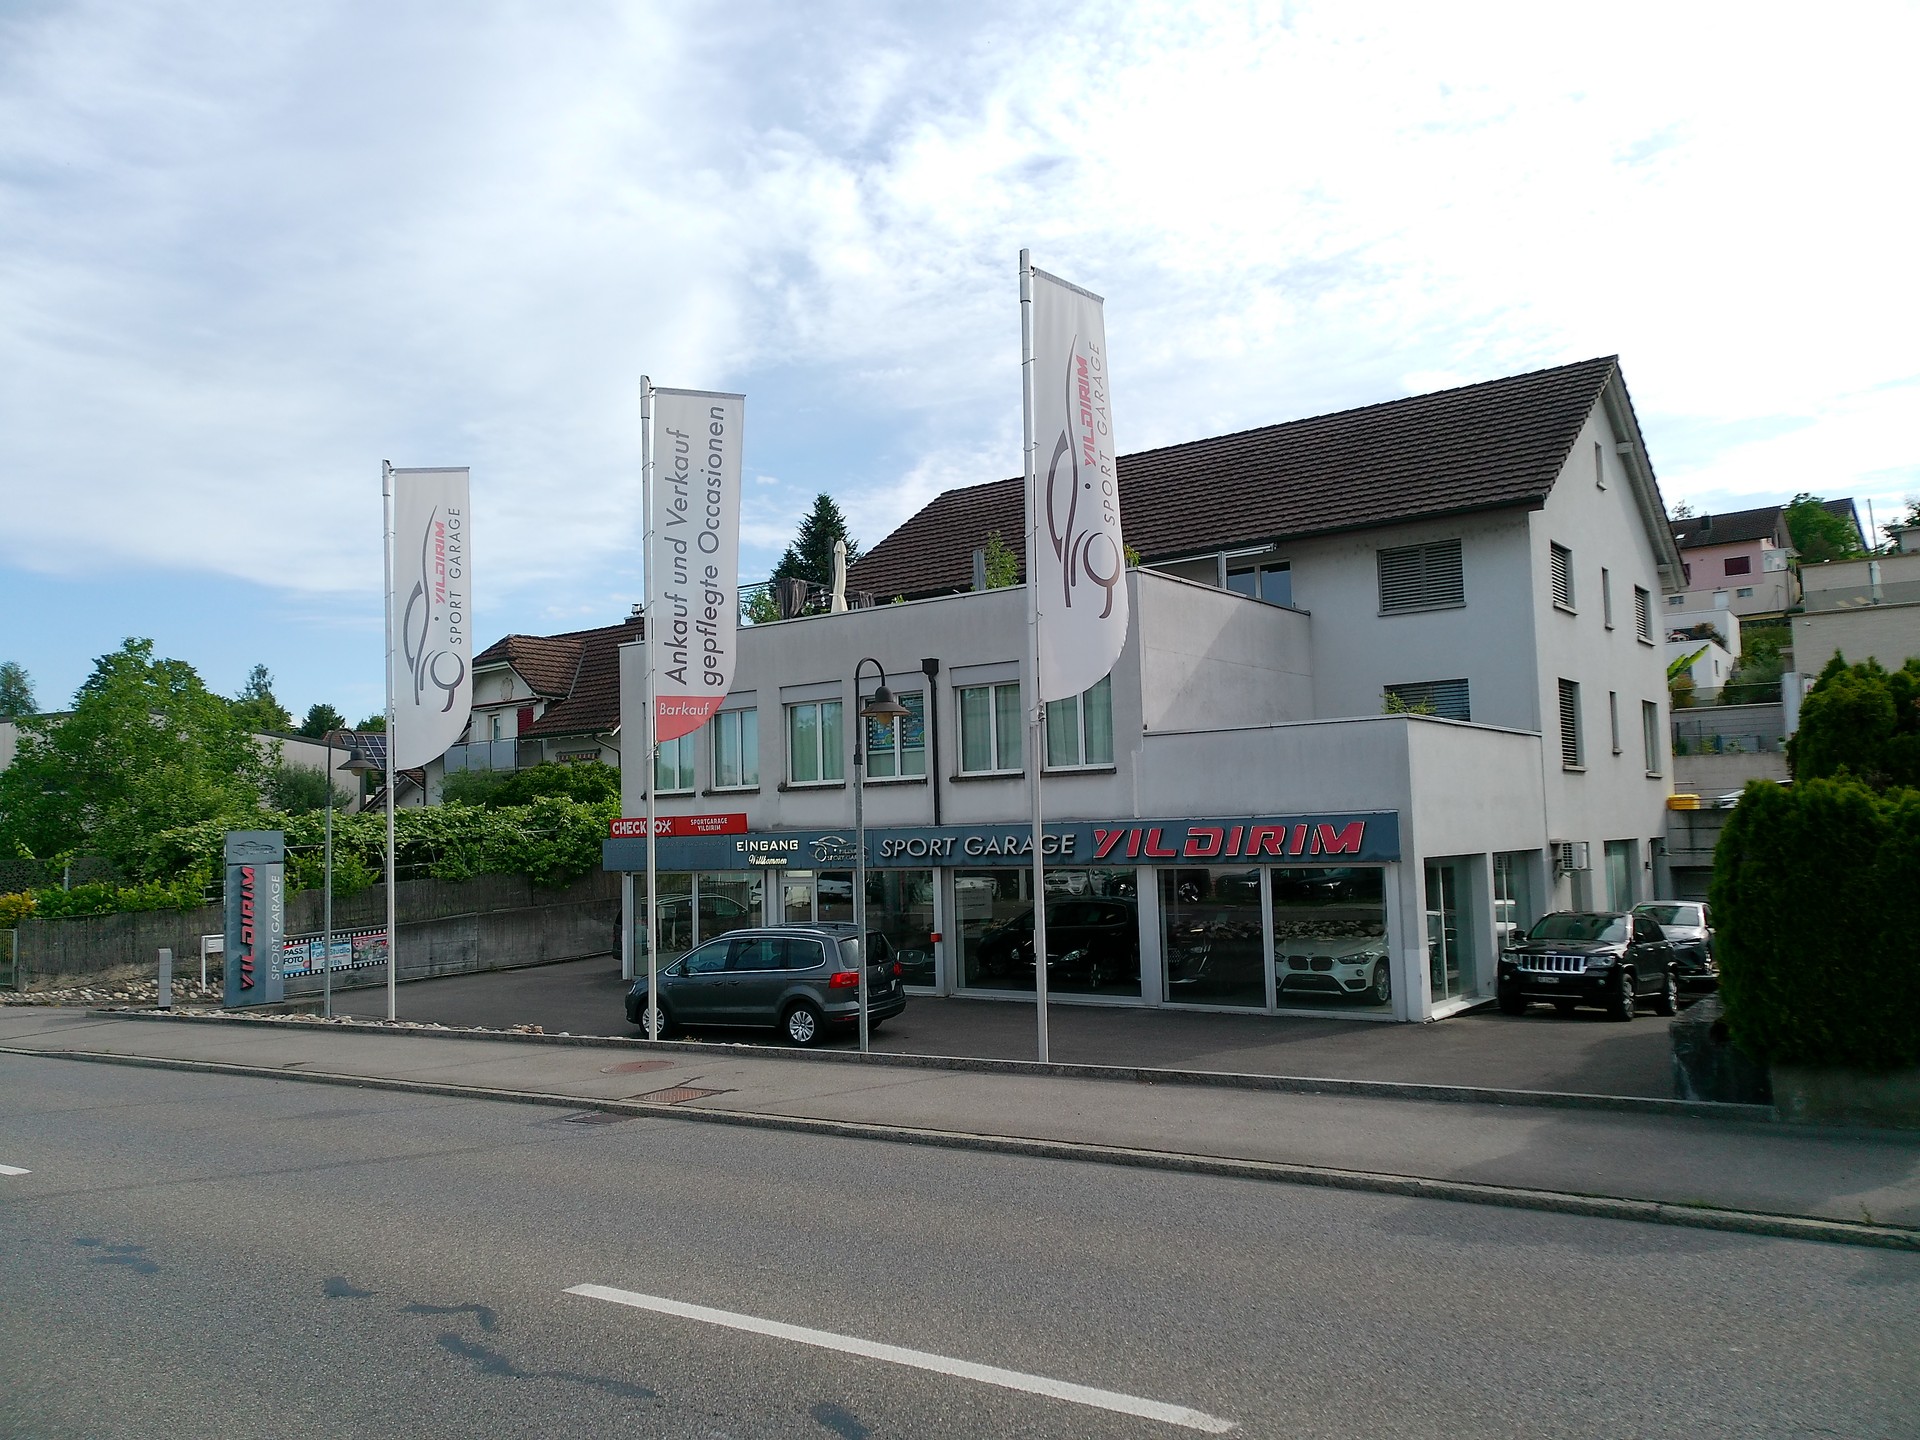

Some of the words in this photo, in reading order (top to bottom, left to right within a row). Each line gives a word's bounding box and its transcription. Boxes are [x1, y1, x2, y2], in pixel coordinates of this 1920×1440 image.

[1075, 354, 1096, 467] YILDIRIM
[1089, 341, 1107, 436] GARAGE
[664, 428, 690, 528] Verkauf
[698, 406, 724, 555] Occasionen
[1100, 451, 1115, 526] SPORT
[435, 521, 446, 604] YILDIRIM
[449, 508, 461, 579] GARAGE
[664, 537, 687, 584] und
[449, 591, 462, 644] SPORT
[664, 592, 687, 685] Ankauf
[697, 565, 724, 687] gepflegte
[660, 702, 709, 716] Barkauf
[612, 820, 672, 835] CHECKOX
[690, 817, 728, 826] SPORTGARAGE
[736, 839, 799, 852] EINGANG
[879, 837, 956, 857] SPORT
[963, 833, 1075, 856] GARAGE
[1093, 821, 1366, 858] YILDIRIM
[748, 854, 788, 865] Willkommen
[241, 866, 255, 989] YILDIRIM
[271, 875, 281, 934] GARAGE
[271, 937, 281, 981] SPORT
[283, 948, 304, 956] PASS
[283, 956, 304, 965] FOTO
